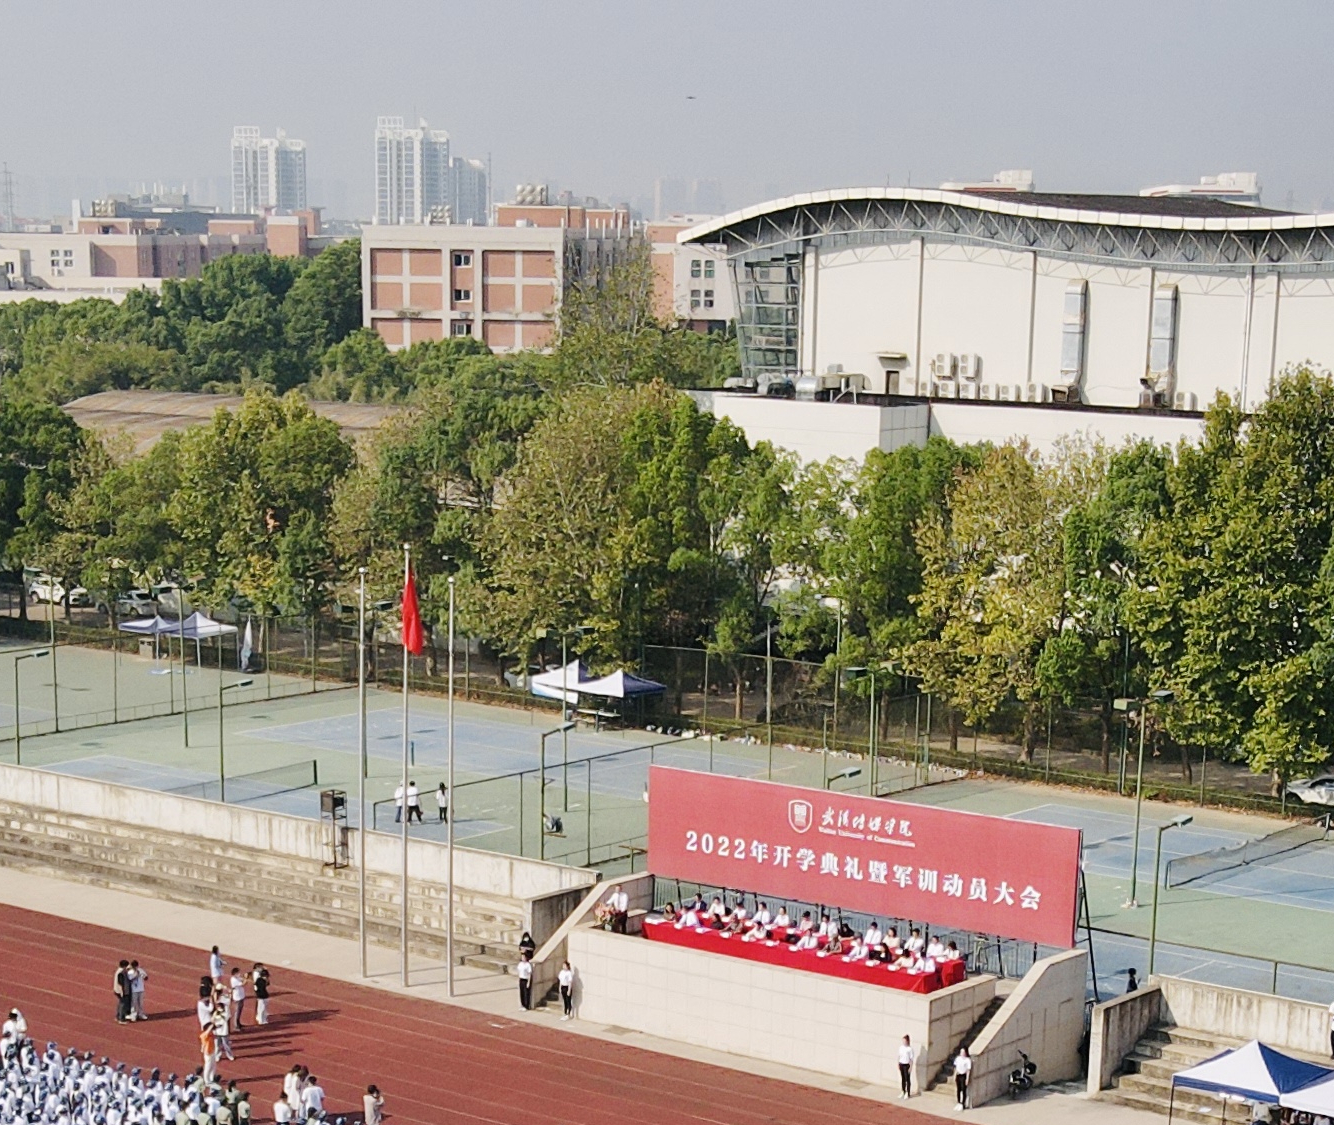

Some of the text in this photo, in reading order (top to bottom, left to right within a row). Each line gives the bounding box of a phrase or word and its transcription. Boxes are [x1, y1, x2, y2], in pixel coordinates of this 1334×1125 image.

[685, 830, 1042, 911] 2022年开学典礼暨军训动员大会
